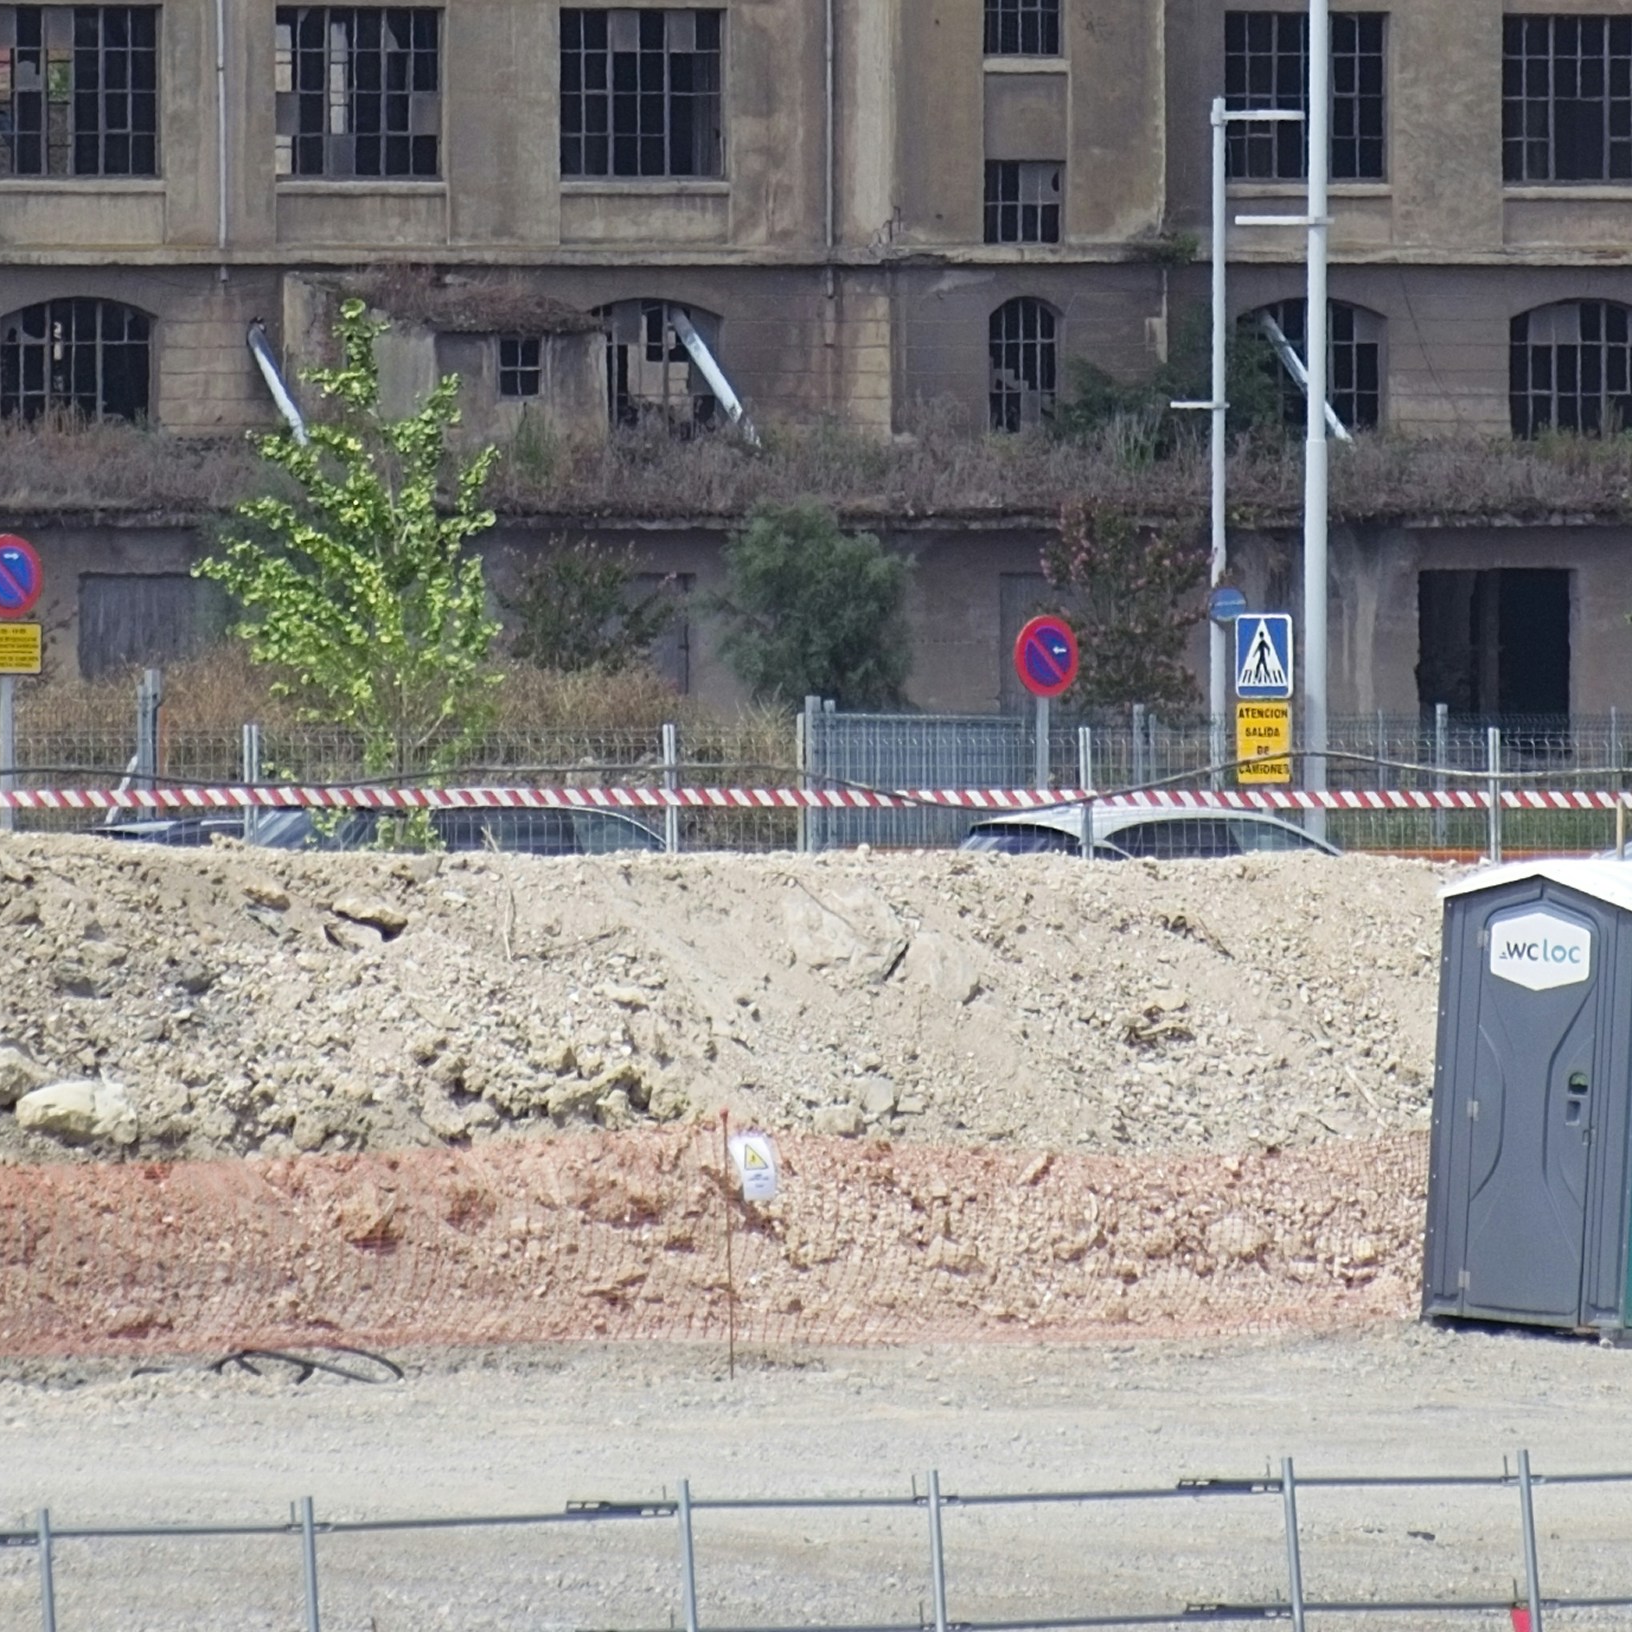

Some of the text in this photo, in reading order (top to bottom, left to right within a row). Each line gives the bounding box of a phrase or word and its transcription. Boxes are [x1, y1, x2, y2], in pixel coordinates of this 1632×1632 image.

[1239, 708, 1288, 718] ATENCION
[1245, 727, 1281, 738] SALIDA
[1257, 746, 1269, 755] DE
